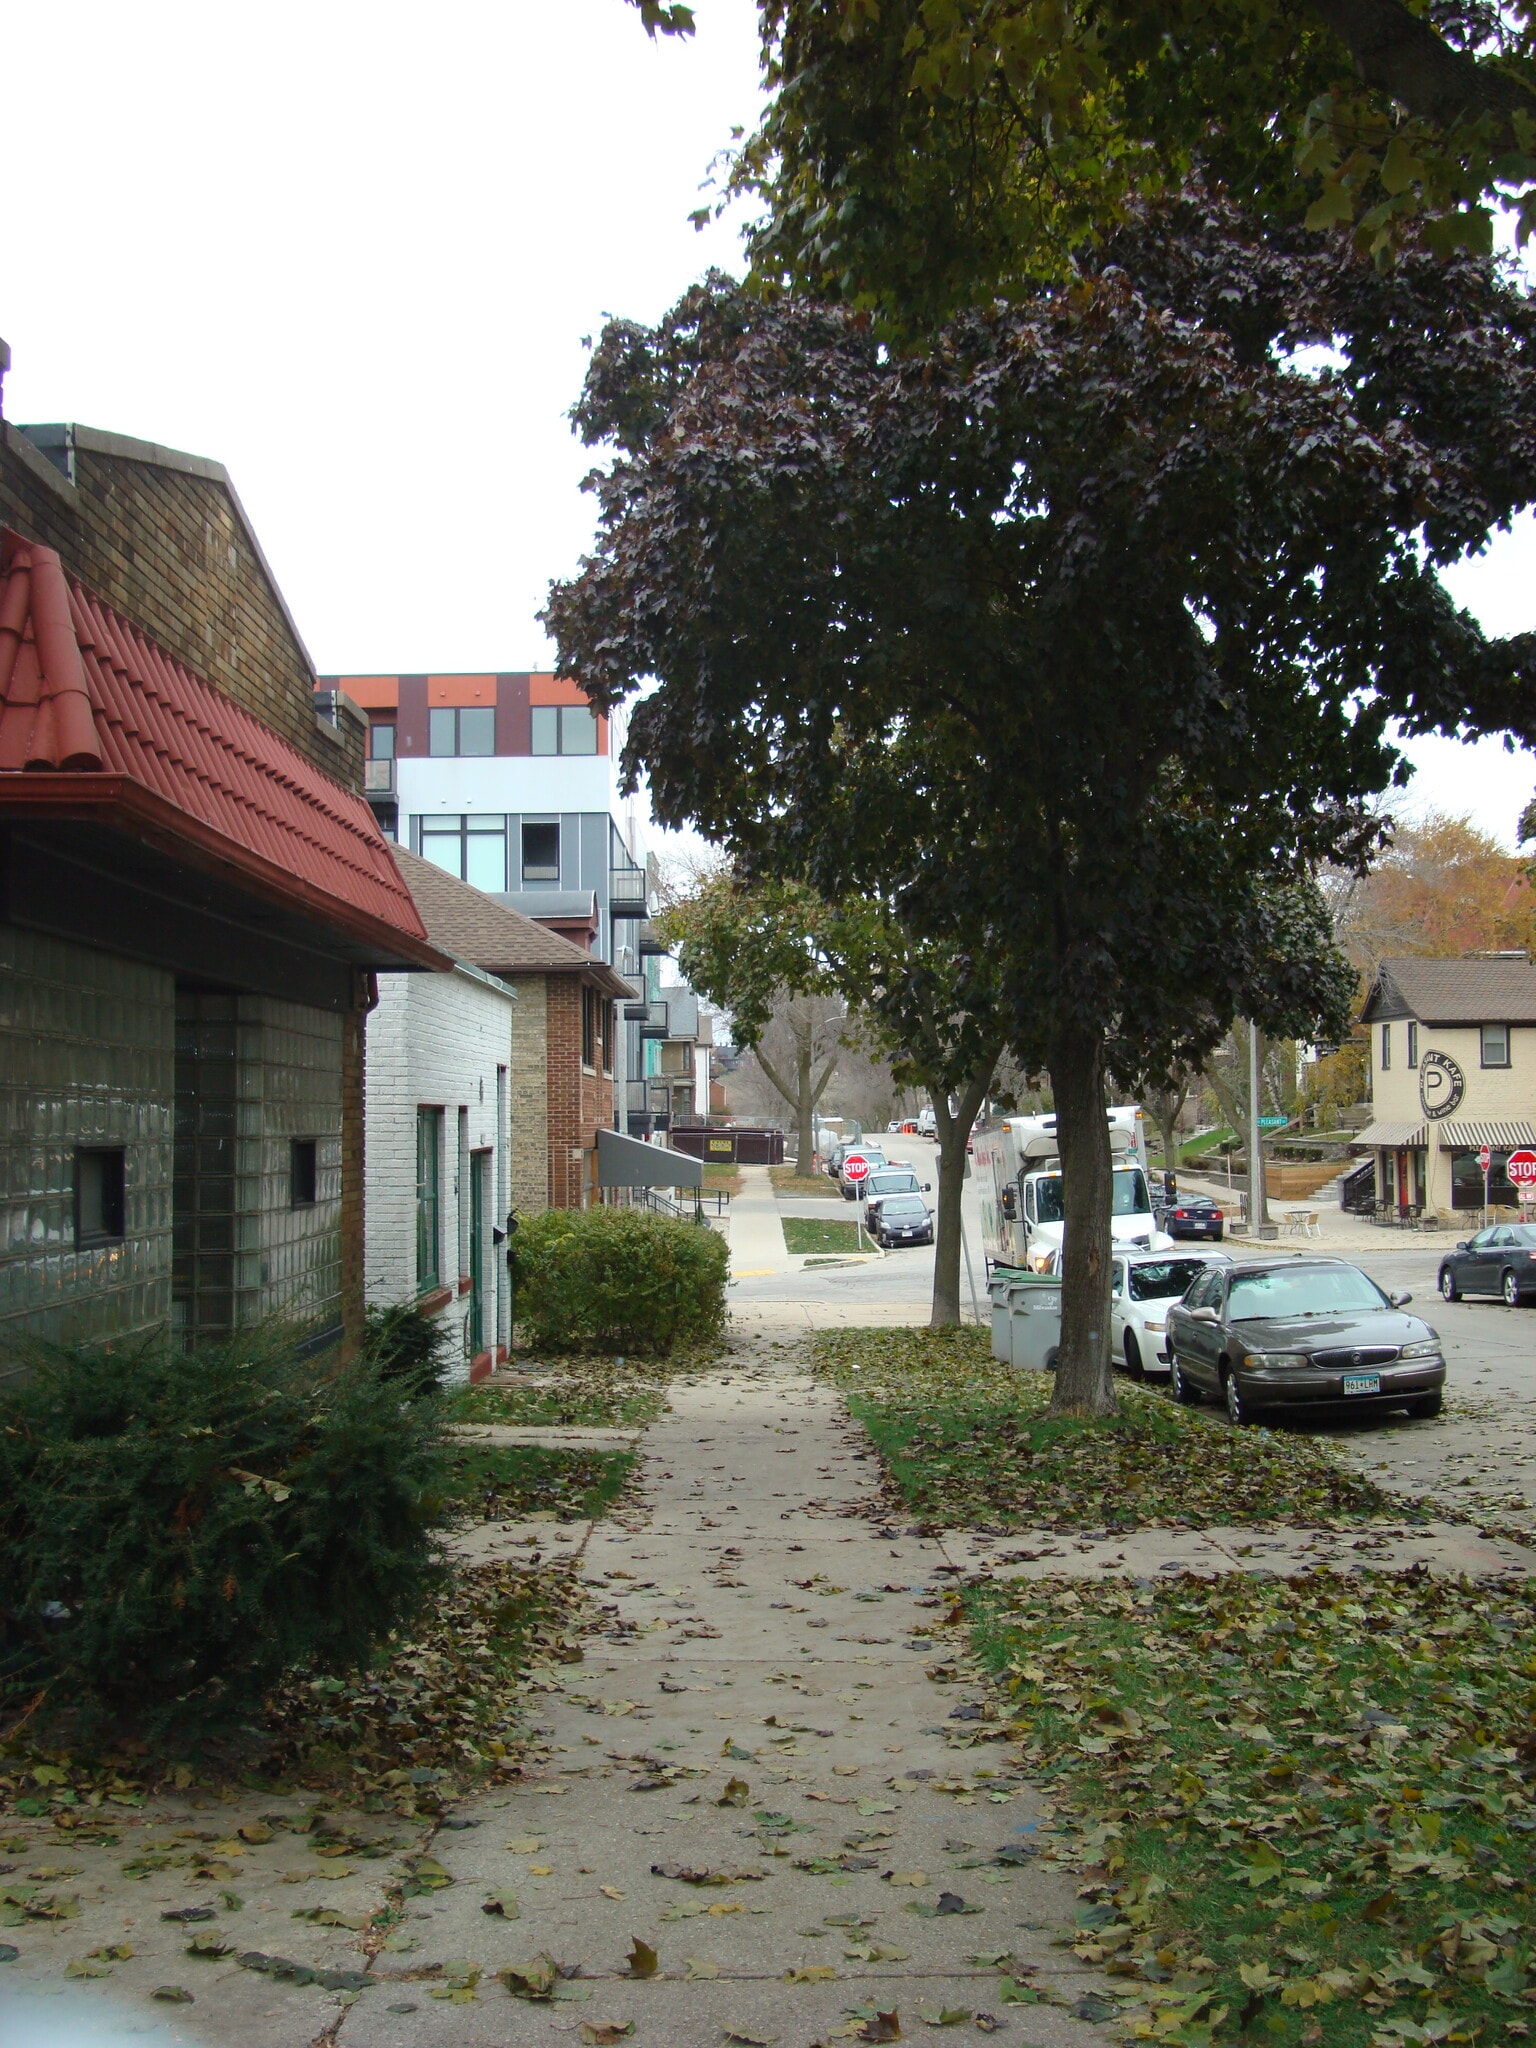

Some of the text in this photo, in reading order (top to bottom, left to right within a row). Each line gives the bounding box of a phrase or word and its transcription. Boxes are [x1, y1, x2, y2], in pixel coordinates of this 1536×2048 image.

[1443, 1059, 1462, 1087] KAFE
[1427, 1072, 1442, 1099] P
[1449, 1094, 1459, 1106] bar
[845, 1163, 868, 1173] STOP
